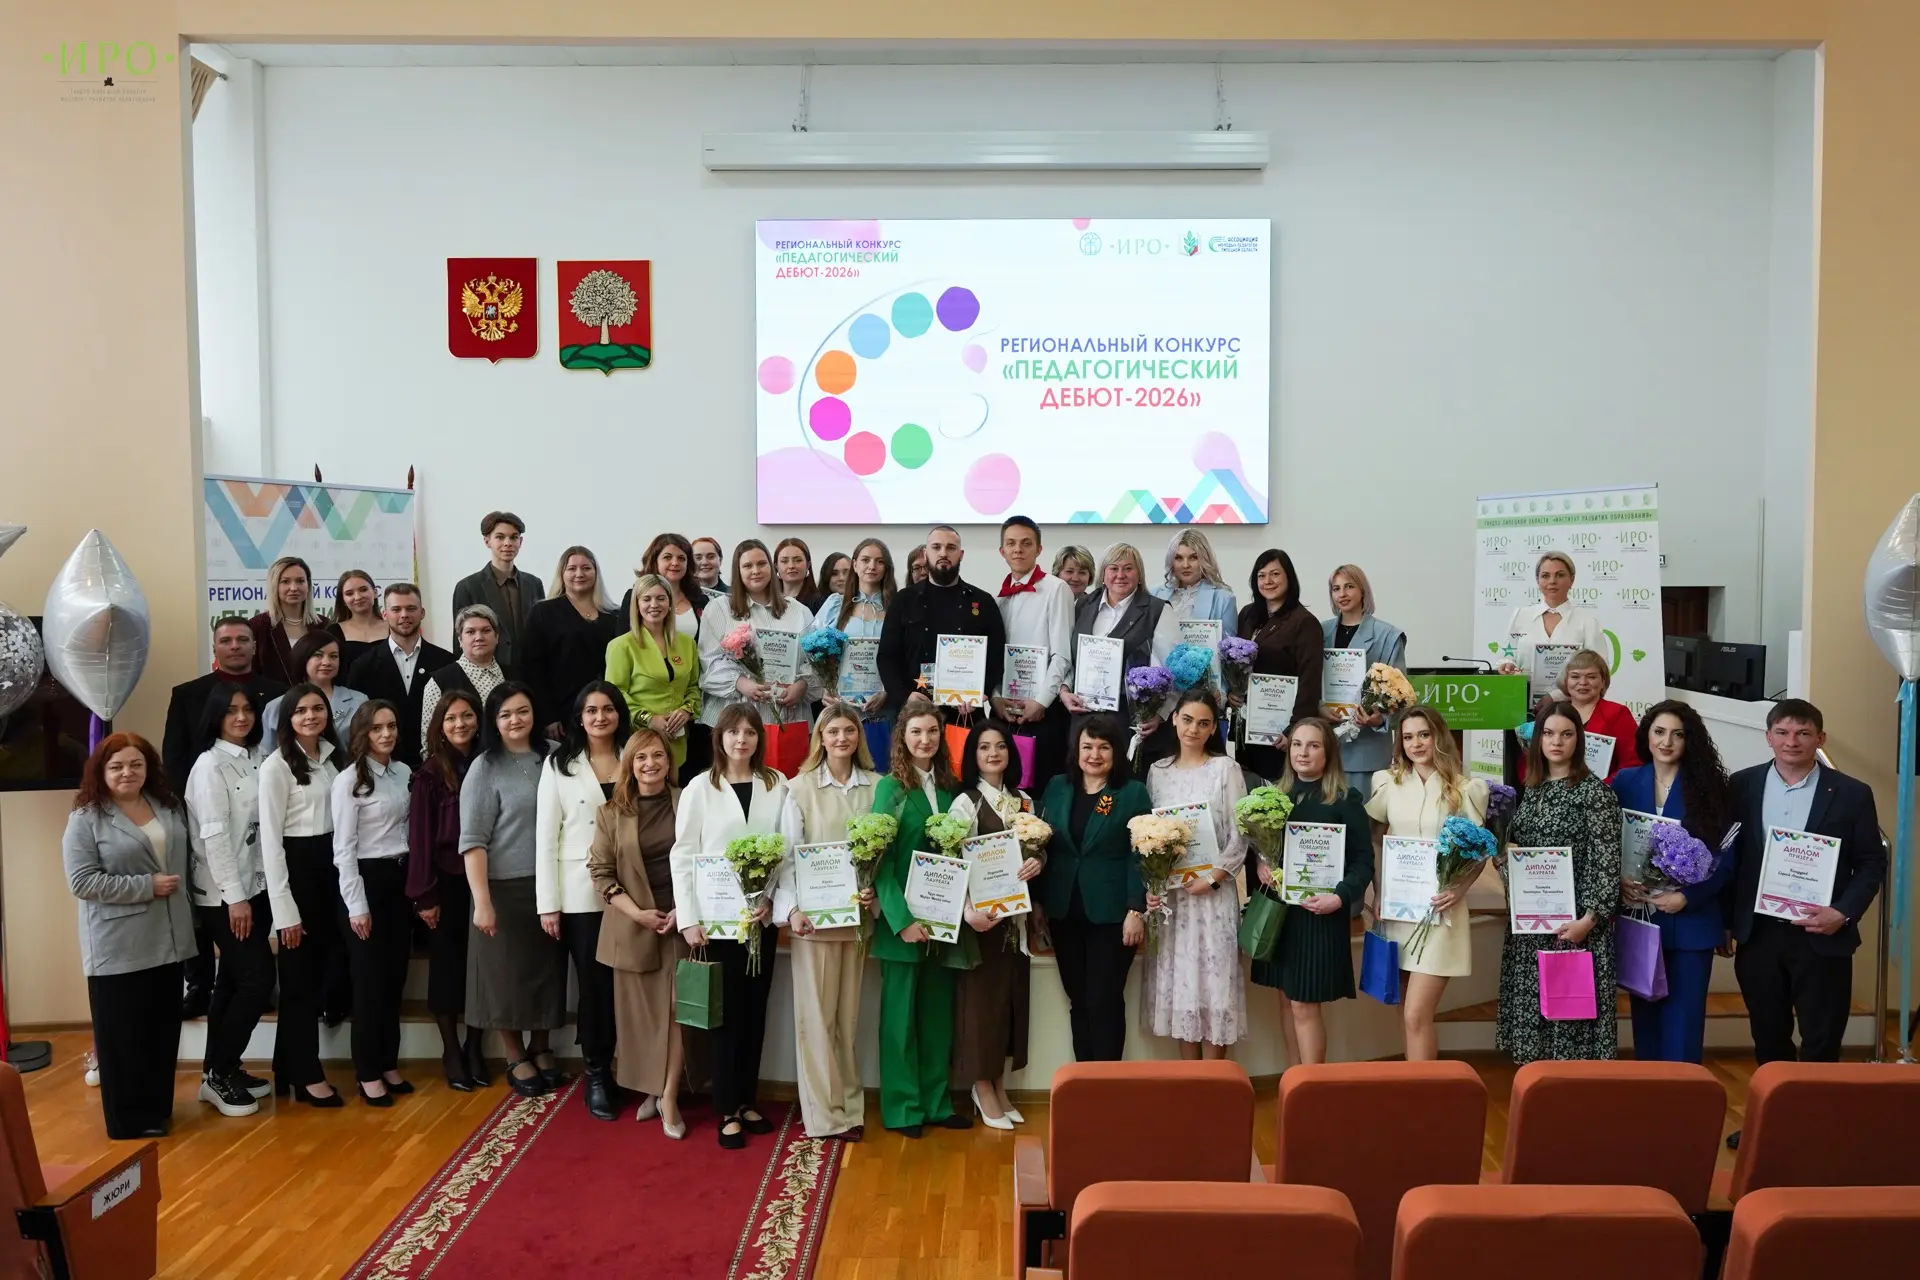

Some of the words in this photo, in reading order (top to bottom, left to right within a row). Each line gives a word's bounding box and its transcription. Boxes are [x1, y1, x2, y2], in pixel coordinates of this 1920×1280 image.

[775, 239, 853, 249] РЕГИОНАЛЬНЫЙ
[855, 240, 901, 249] КОНКУРС
[1117, 239, 1162, 255] ИРО
[775, 250, 899, 264] «ПЕДАГОГИЧЕСКИЙ
[775, 267, 860, 279] ДЕБЮТ-2026»
[1000, 334, 1148, 353] РЕГИОНАЛЬНЫЙ
[1154, 337, 1241, 353] КОНКУРС
[1002, 354, 1238, 382] «ПЕДАГОГИЧЕСКИЙ
[1040, 387, 1201, 410] ДЕБЮТ-2026»
[1486, 536, 1508, 547] ИРО
[1527, 535, 1550, 546] ИРО
[1571, 533, 1597, 544] ИРО
[1620, 531, 1648, 543] ИРО
[1503, 561, 1527, 573] ИРО
[1592, 560, 1619, 572] ИРО
[1484, 587, 1508, 598] ИРО
[1572, 588, 1598, 599] ИРО
[1621, 588, 1650, 600] ИРО
[763, 642, 787, 650] ДИПЛОМ
[1423, 683, 1480, 704] ИРО
[1300, 838, 1330, 846] ДИПЛОМ
[977, 848, 1006, 859] ДИПЛОМ
[1783, 846, 1820, 858] ДИПЛОМ
[1788, 853, 1814, 862] ПРИЗЕРА
[810, 859, 841, 868] ДИПЛОМ
[924, 871, 954, 881] ДИПЛОМ
[925, 877, 950, 885] ЛАУРЕАТА
[103, 1179, 131, 1205] ЖЮРИ
